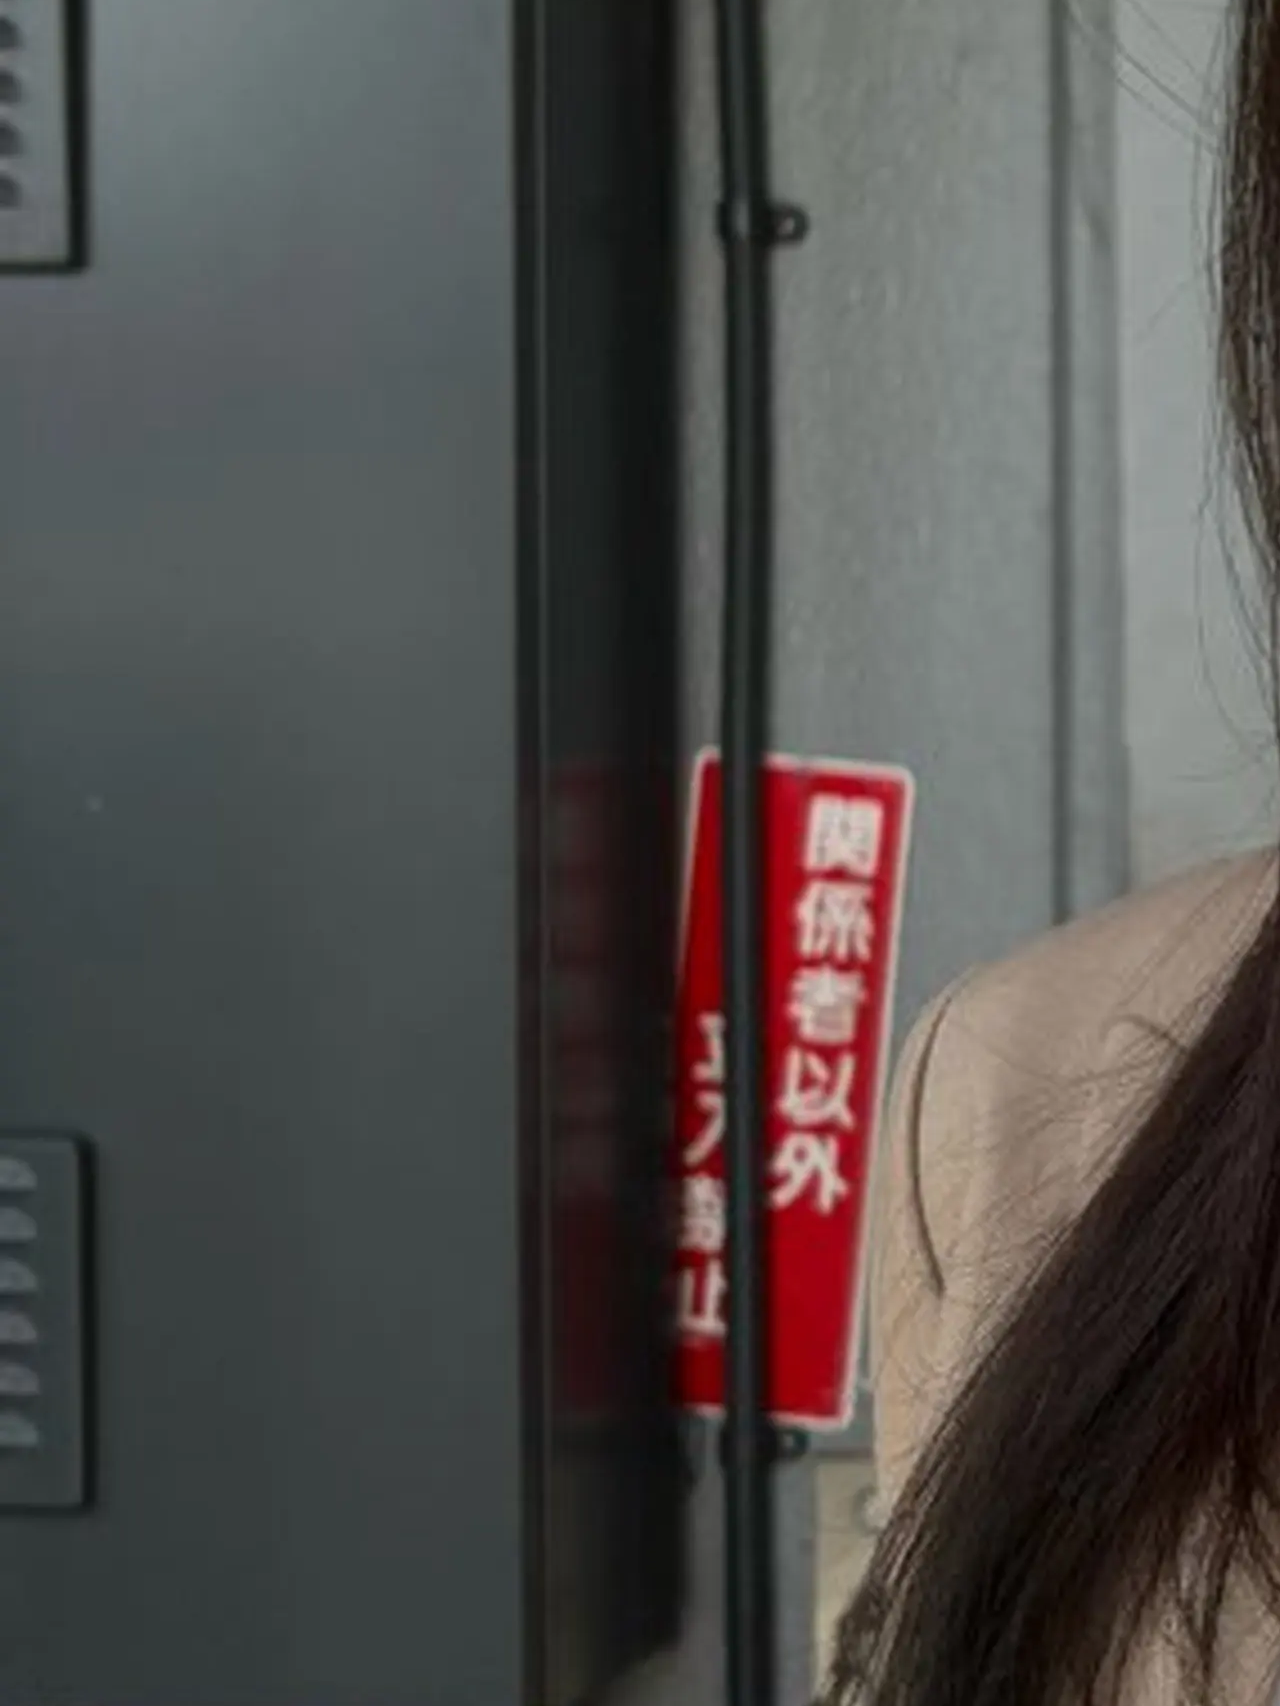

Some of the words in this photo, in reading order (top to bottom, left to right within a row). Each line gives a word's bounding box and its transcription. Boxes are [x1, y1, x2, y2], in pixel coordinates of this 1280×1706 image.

[770, 795, 882, 1213] 関係者以外
